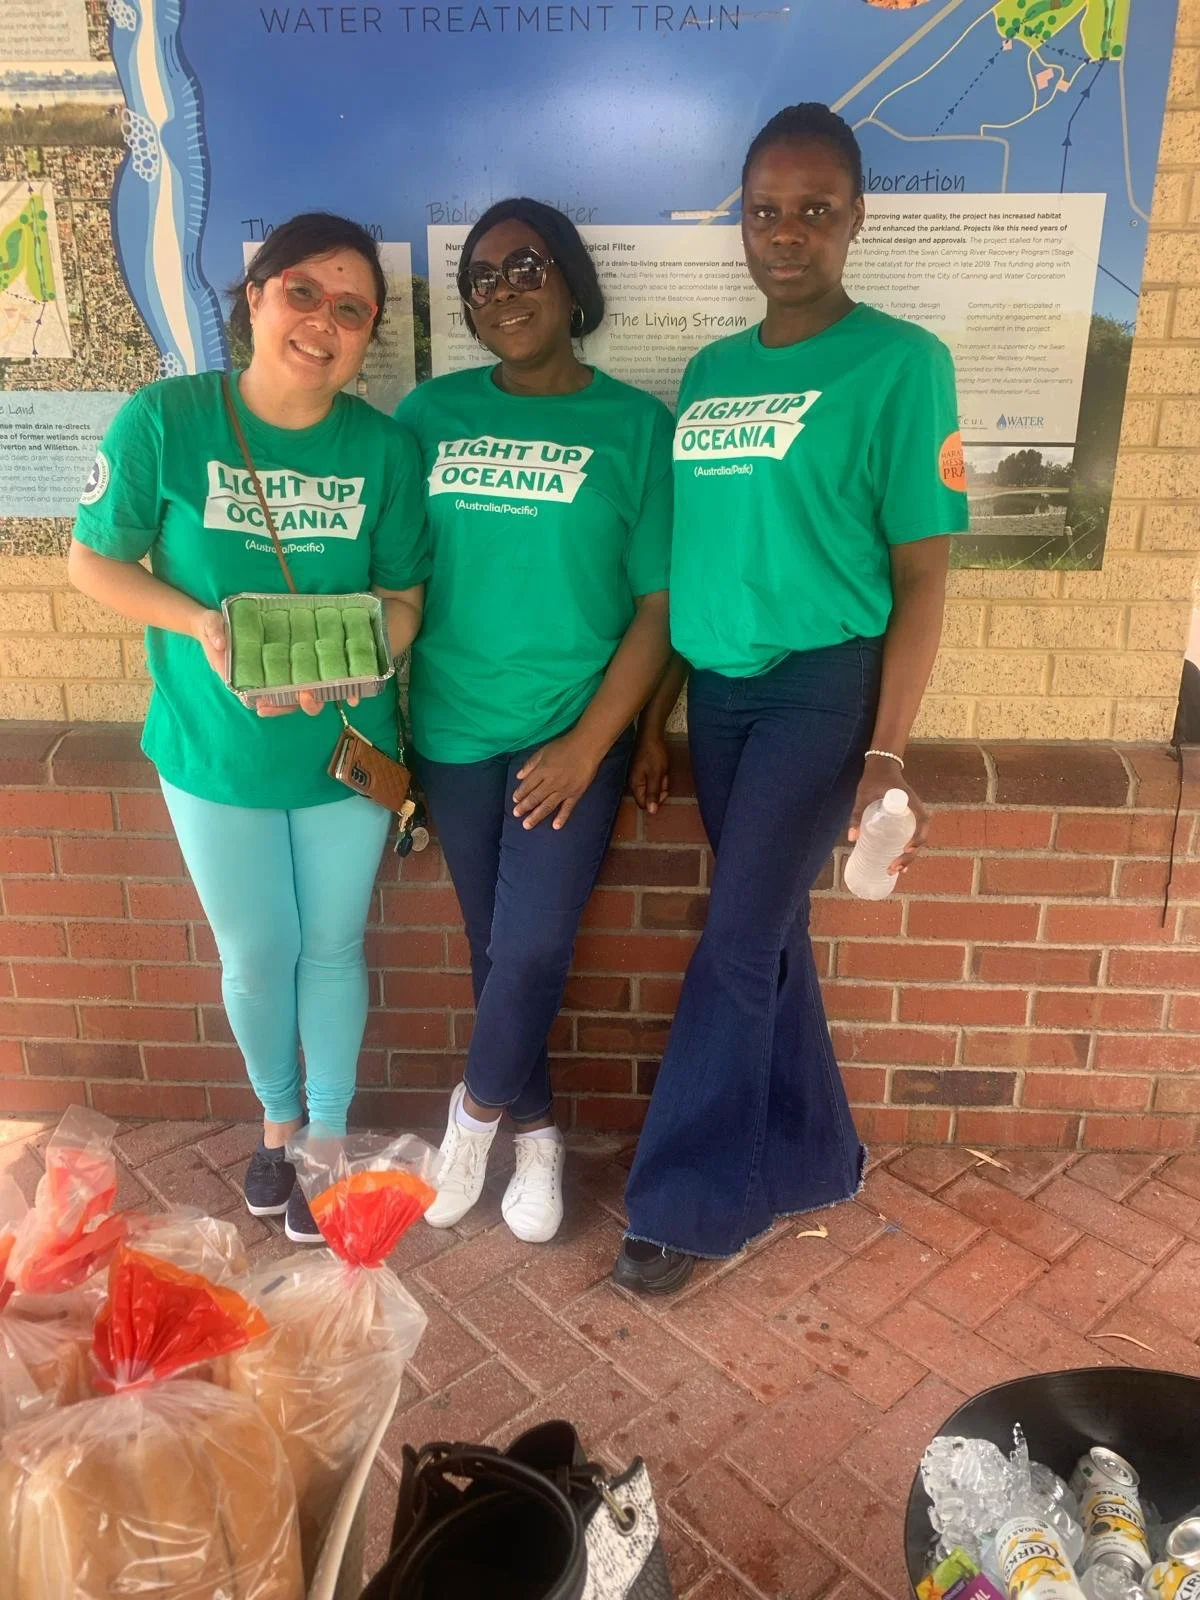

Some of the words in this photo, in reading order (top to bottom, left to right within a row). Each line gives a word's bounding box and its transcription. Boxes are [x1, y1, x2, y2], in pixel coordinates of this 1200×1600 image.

[260, 7, 383, 33] WATER
[399, 5, 614, 33] TREATMENT
[632, 4, 740, 32] TRAIN
[426, 201, 484, 225] Biolo
[866, 212, 901, 221] improving
[902, 212, 922, 221] water
[923, 212, 948, 221] quality,
[950, 212, 961, 221] the
[963, 212, 987, 221] project
[989, 212, 1001, 221] has
[1003, 212, 1035, 221] increased
[1037, 212, 1062, 221] habitat
[241, 218, 275, 241] Th
[868, 224, 881, 233] and
[883, 224, 915, 233] enhanced
[917, 224, 928, 233] the
[930, 224, 962, 233] parkland.
[964, 224, 991, 233] Projects
[993, 224, 1005, 233] like
[1006, 224, 1019, 233] this
[1020, 224, 1038, 233] need
[1040, 224, 1058, 233] years
[1060, 224, 1068, 233] of
[583, 242, 610, 253] ogical
[612, 242, 636, 252] Filter
[862, 237, 893, 245] technical
[894, 237, 917, 245] design
[918, 237, 931, 245] and
[933, 237, 968, 245] approvals.
[597, 260, 605, 268] of
[606, 260, 610, 268] a
[611, 260, 658, 270] drain-to-living
[660, 260, 682, 268] stream
[684, 260, 720, 268] conversion
[722, 260, 734, 268] and
[610, 313, 640, 327] The
[644, 312, 688, 333] Living
[692, 312, 748, 328] Stream
[9, 404, 35, 415] Land
[687, 399, 764, 421] LIGHT
[765, 395, 806, 414] UP
[1007, 416, 1045, 427] WATER
[29, 444, 42, 452] and
[681, 426, 776, 452] OCEANIA
[444, 440, 533, 461] LIGHT
[540, 445, 583, 465] UP
[217, 466, 307, 498] LIGHT
[316, 480, 356, 503] UP
[441, 467, 564, 493] OCEANIA
[226, 502, 348, 531] OCEANIA
[455, 499, 538, 517] (Australia/Pacific)
[245, 539, 325, 554] (Austraa/Pacific)
[1179, 1574, 1200, 1600] KIR
